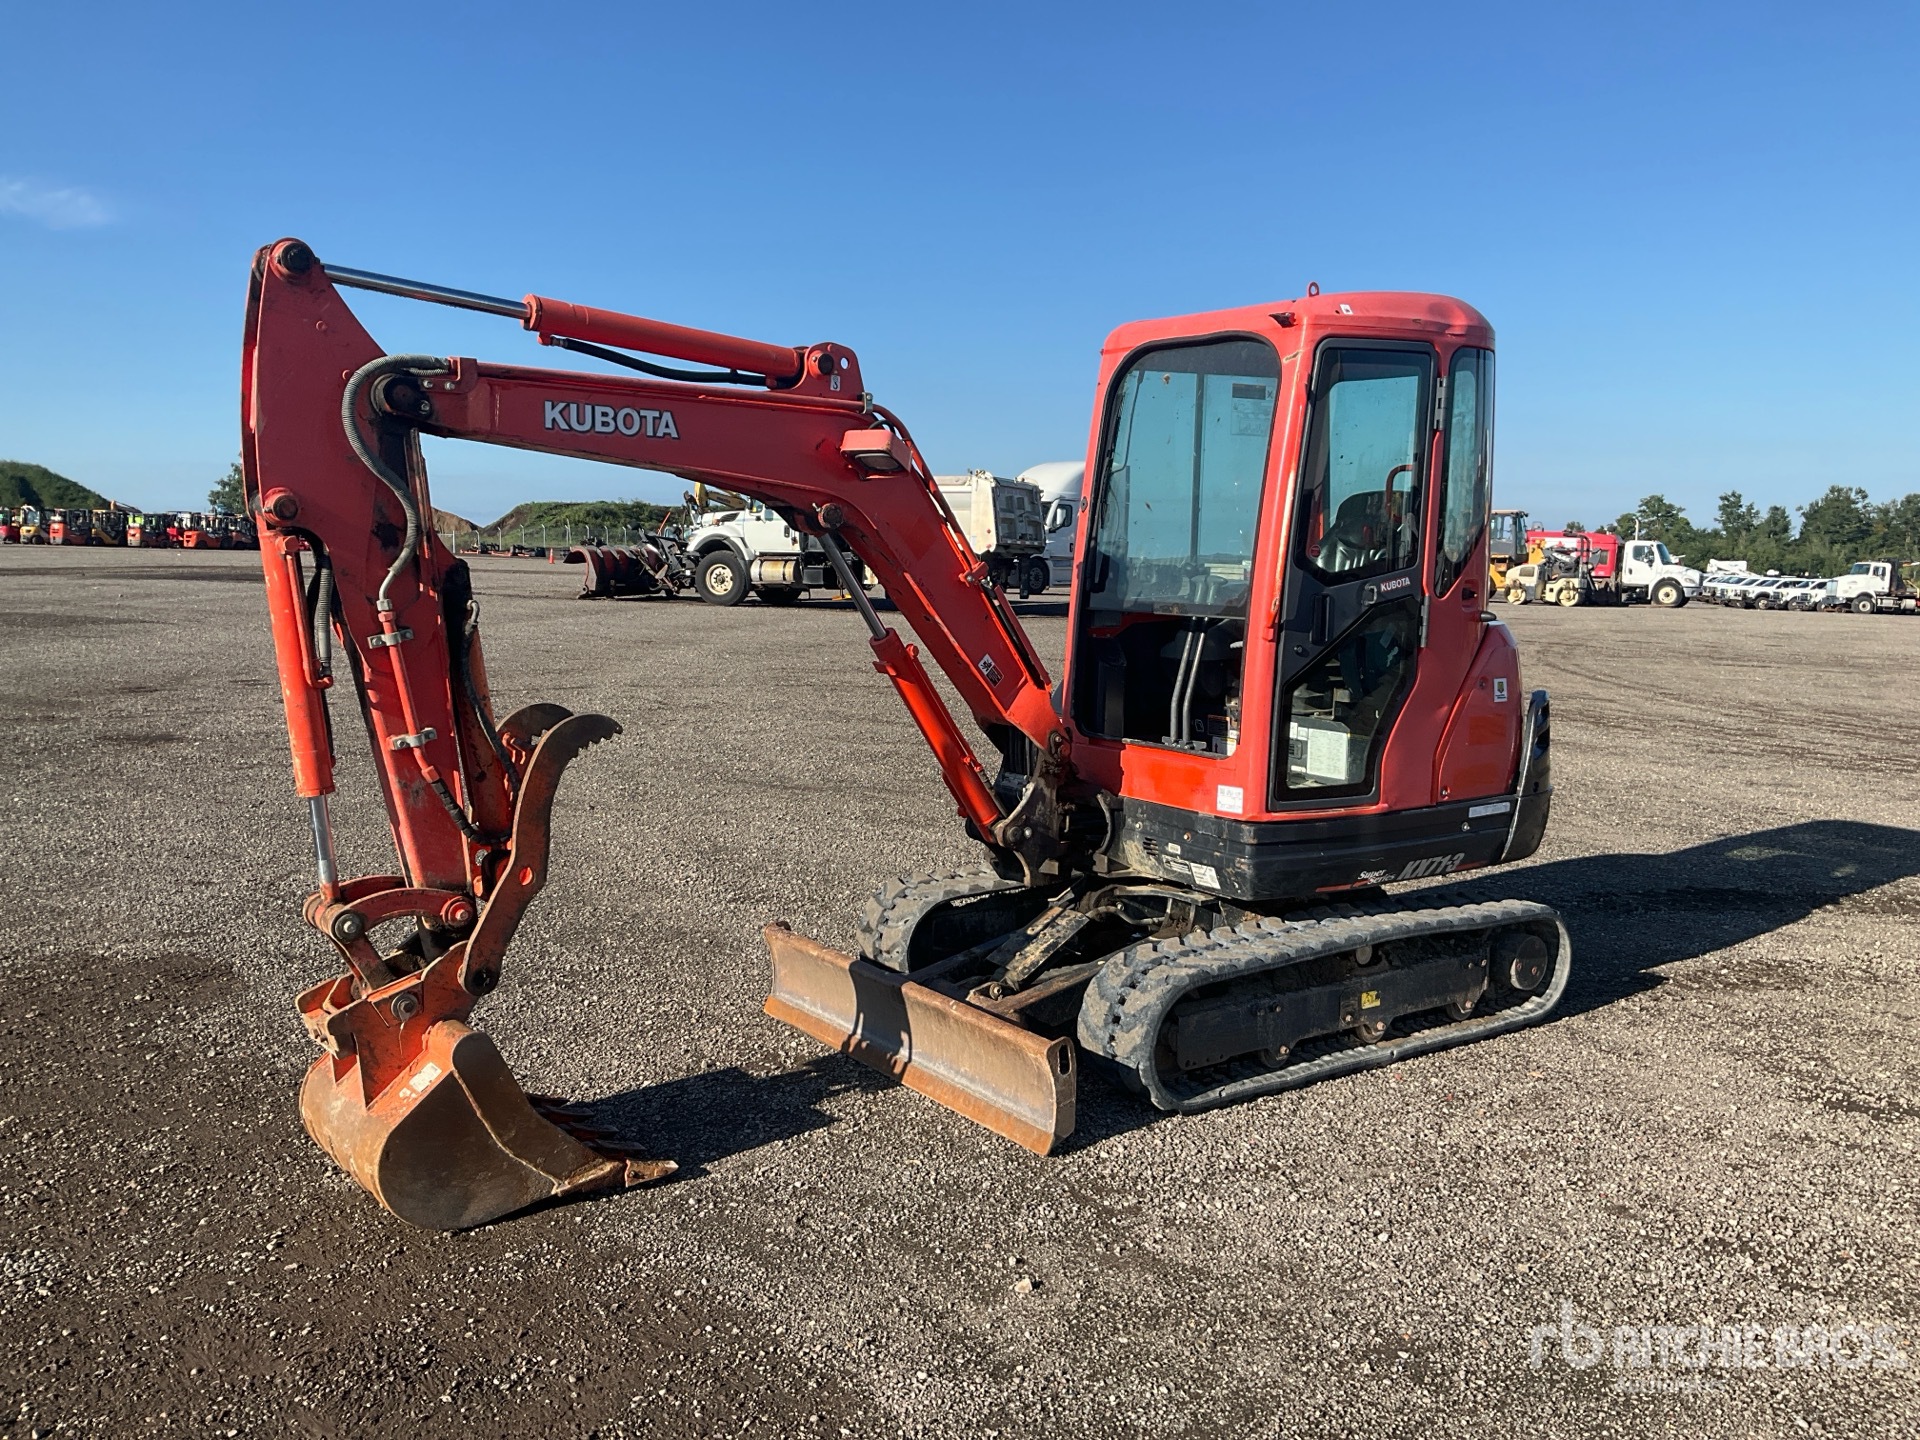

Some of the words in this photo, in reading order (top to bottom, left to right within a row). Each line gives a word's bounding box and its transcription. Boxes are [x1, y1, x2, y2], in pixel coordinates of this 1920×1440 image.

[543, 400, 680, 440] KUBOTA
[1380, 576, 1411, 592] KUBOTA
[1357, 868, 1388, 880] Super
[1366, 873, 1397, 885] Series
